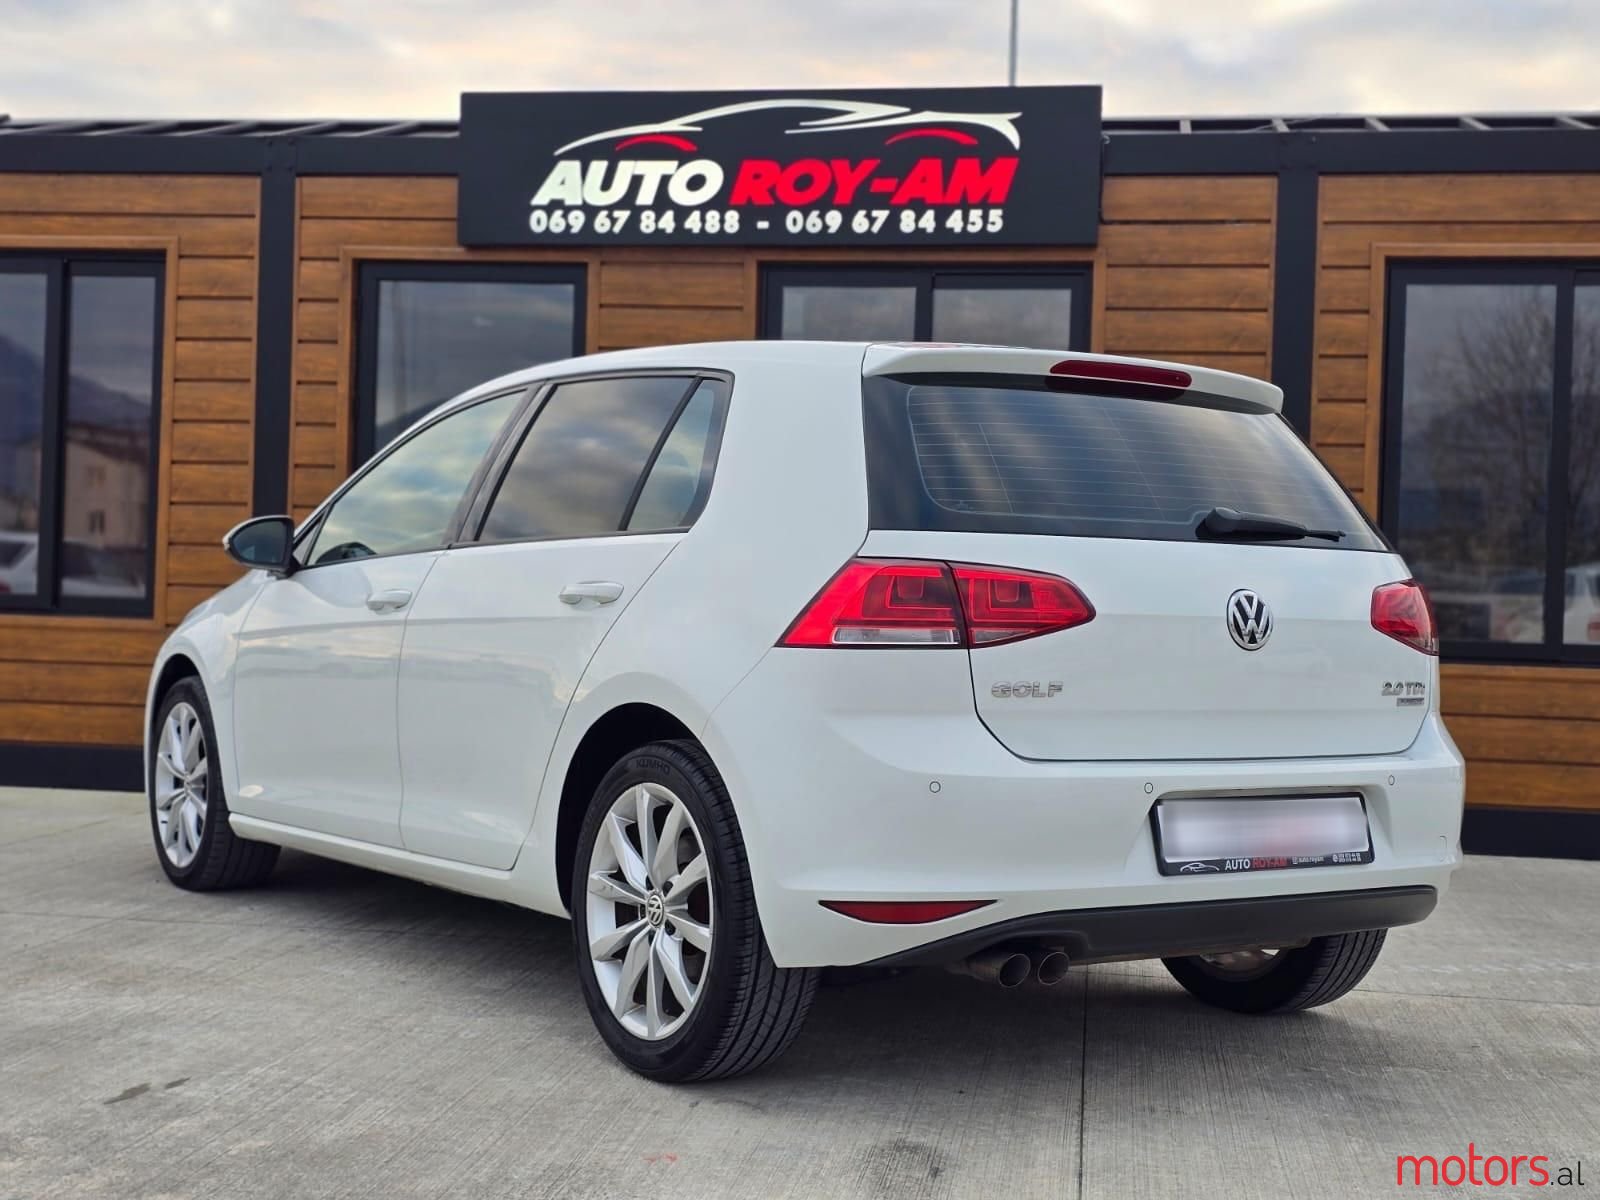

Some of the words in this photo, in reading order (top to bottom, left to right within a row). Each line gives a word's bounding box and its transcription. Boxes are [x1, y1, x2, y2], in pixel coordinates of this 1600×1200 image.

[530, 159, 724, 206] AUTO
[728, 157, 1020, 206] ROY-AM
[529, 209, 585, 234] 069
[594, 209, 631, 234] 67
[639, 209, 676, 234] 84
[683, 209, 740, 234] 488
[785, 209, 843, 234] 069
[851, 209, 890, 234] 67
[899, 209, 936, 234] 84
[945, 208, 1004, 234] 455
[991, 681, 1063, 698] GOLF
[636, 759, 671, 776] KUMHO
[1224, 858, 1251, 871] AUTO
